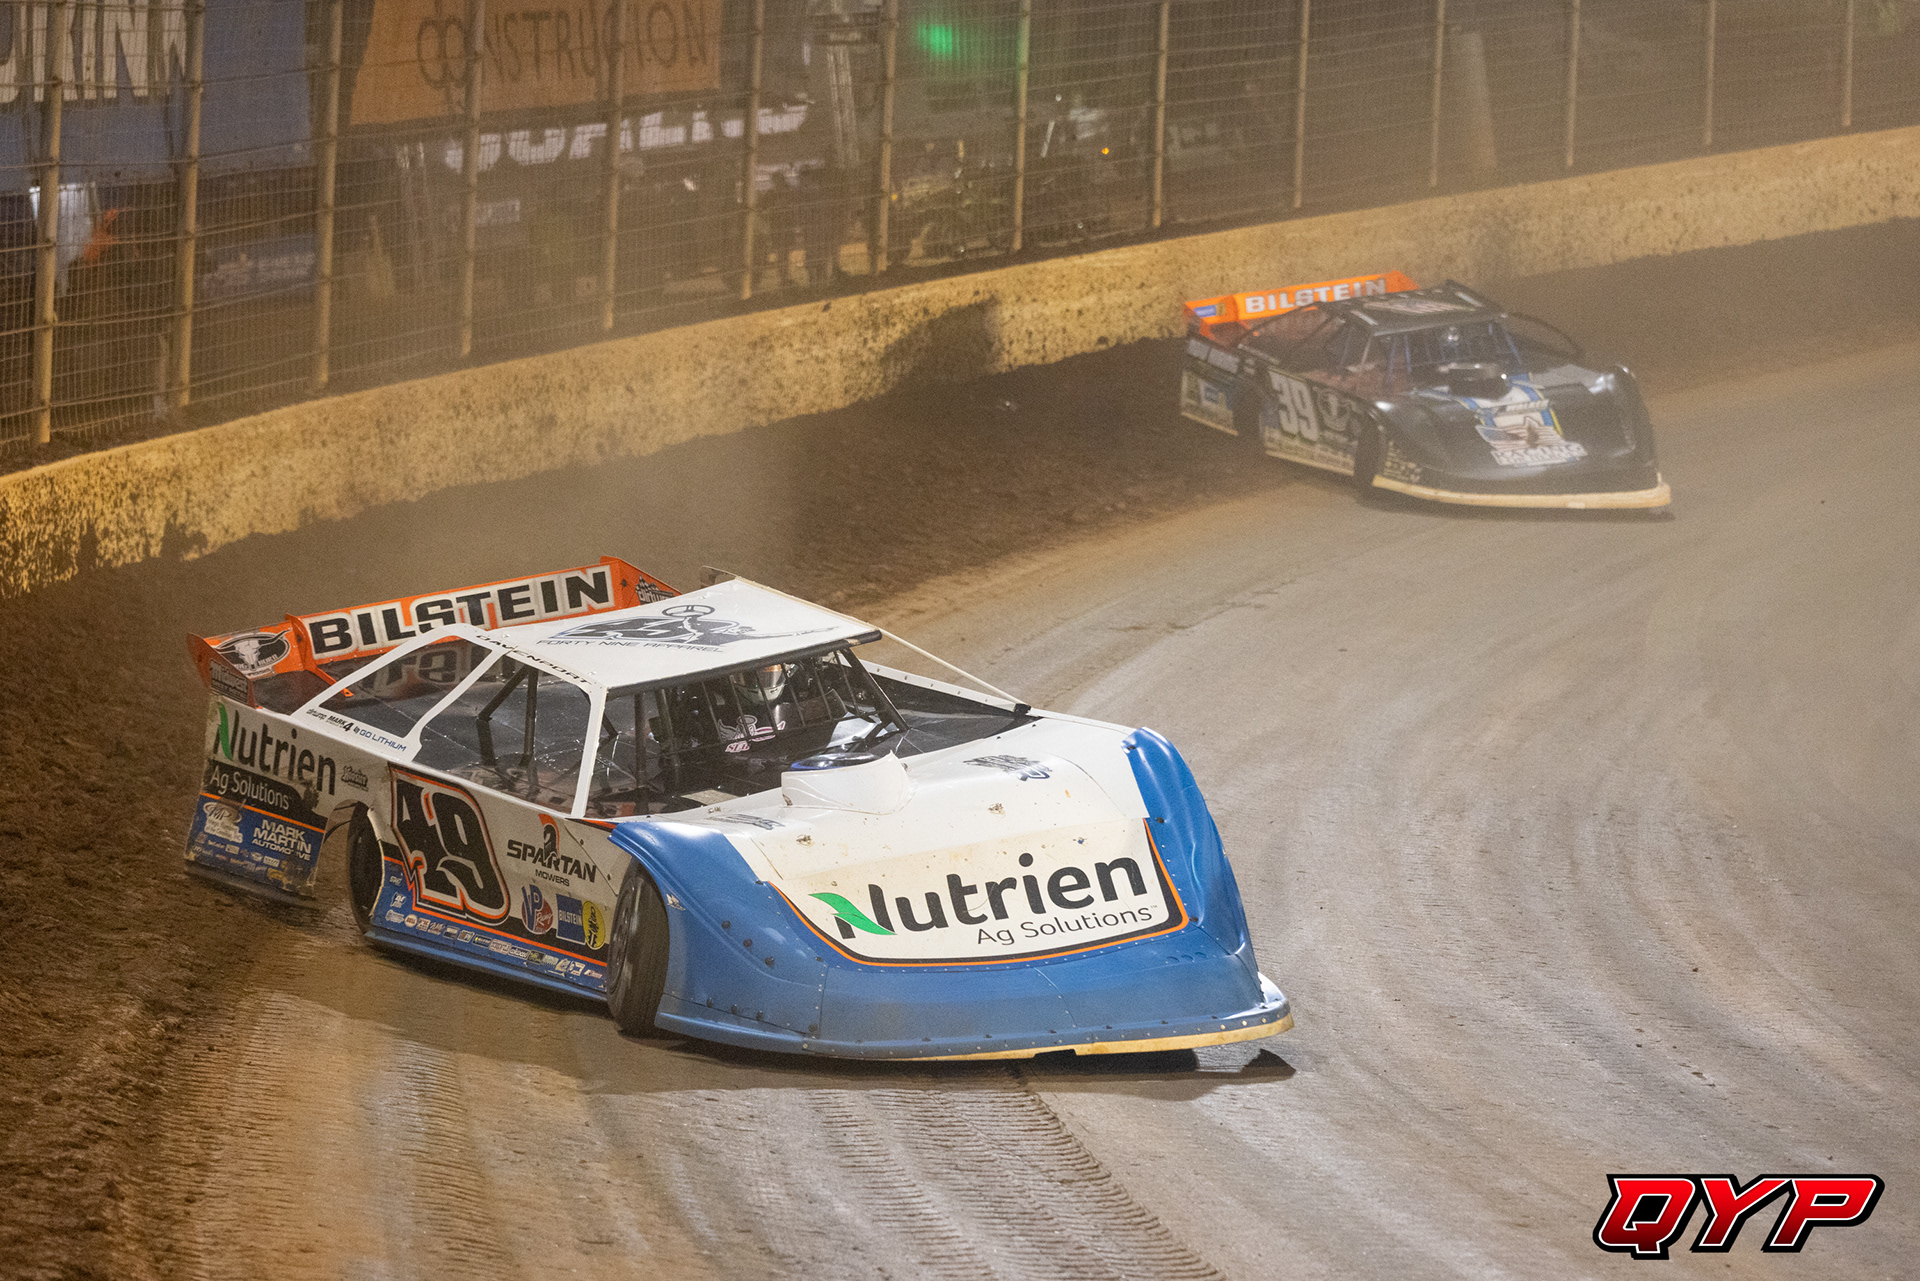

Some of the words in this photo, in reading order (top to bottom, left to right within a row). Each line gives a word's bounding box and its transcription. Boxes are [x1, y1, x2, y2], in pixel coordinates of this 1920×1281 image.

[417, 2, 708, 88] CONSTRUCION
[1245, 278, 1388, 314] BILSTEIN
[1268, 371, 1319, 441] 39
[309, 571, 612, 655] BILSTEIN
[475, 634, 593, 685] DAVENPORT
[536, 639, 592, 647] FORTY
[598, 640, 640, 648] NINE
[643, 641, 724, 653] APPAREL
[213, 701, 336, 796] Nutrien
[360, 729, 373, 739] GO
[371, 733, 407, 752] LITHIUM
[210, 765, 230, 795] Ag
[231, 772, 290, 810] Solutions
[252, 838, 311, 861] AUTOMOVE
[253, 827, 312, 854] MARTIN
[262, 819, 305, 841] MARK
[507, 839, 597, 883] SPARTAN
[535, 869, 570, 887] MOWERS
[521, 884, 544, 931] VP
[808, 852, 1148, 940] Nutrien
[558, 909, 583, 927] BILSTEIN
[977, 927, 1016, 946] Ag
[1024, 906, 1153, 940] Solutions
